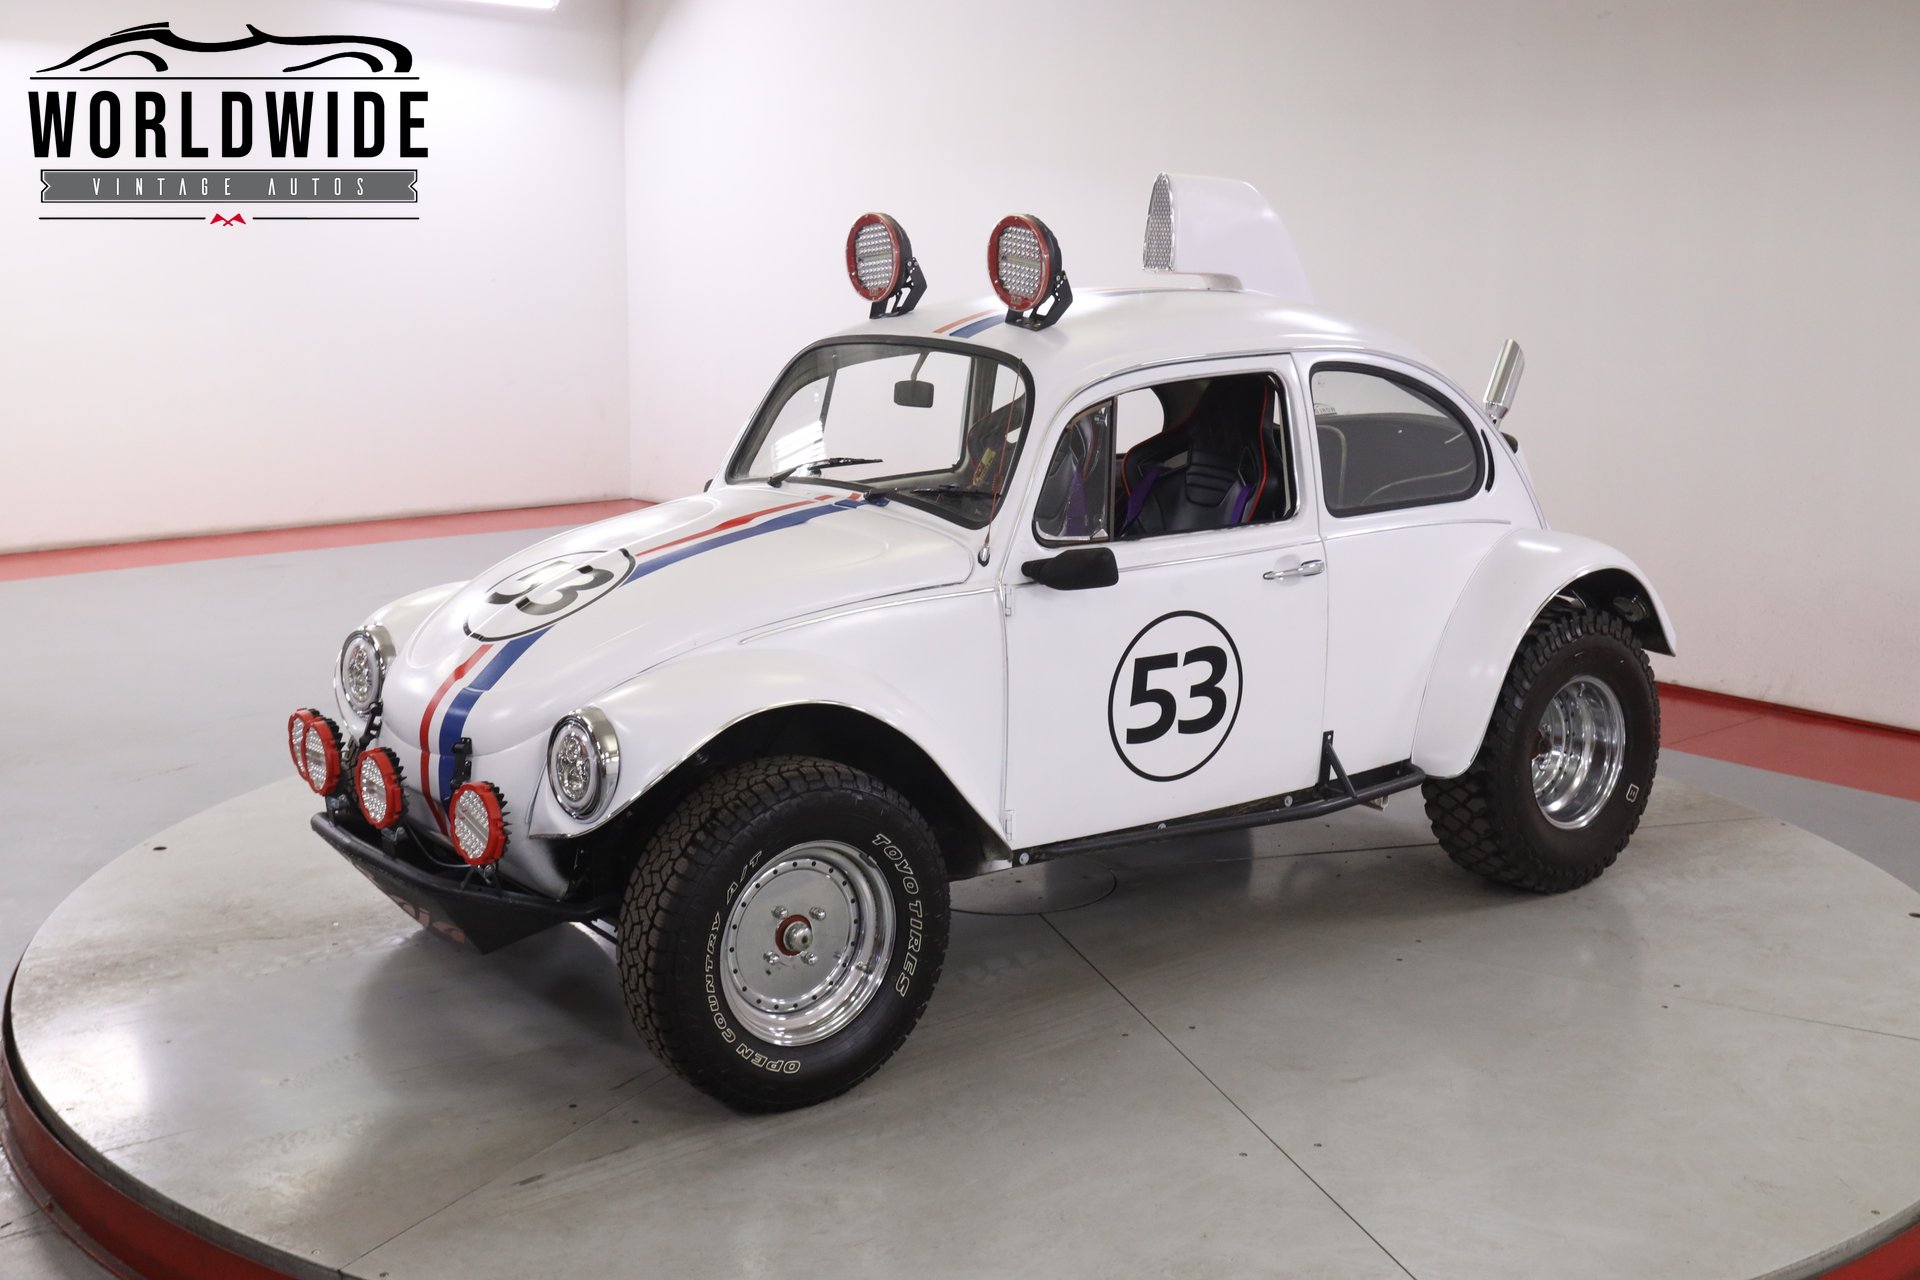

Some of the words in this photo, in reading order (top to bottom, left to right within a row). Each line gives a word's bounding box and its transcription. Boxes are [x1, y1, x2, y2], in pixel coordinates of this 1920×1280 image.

[1126, 645, 1228, 744] 53
[871, 833, 919, 895] TOYO
[895, 900, 924, 997] TIRES
[704, 911, 736, 1044] COUNTRY
[736, 1042, 801, 1074] OPEN
